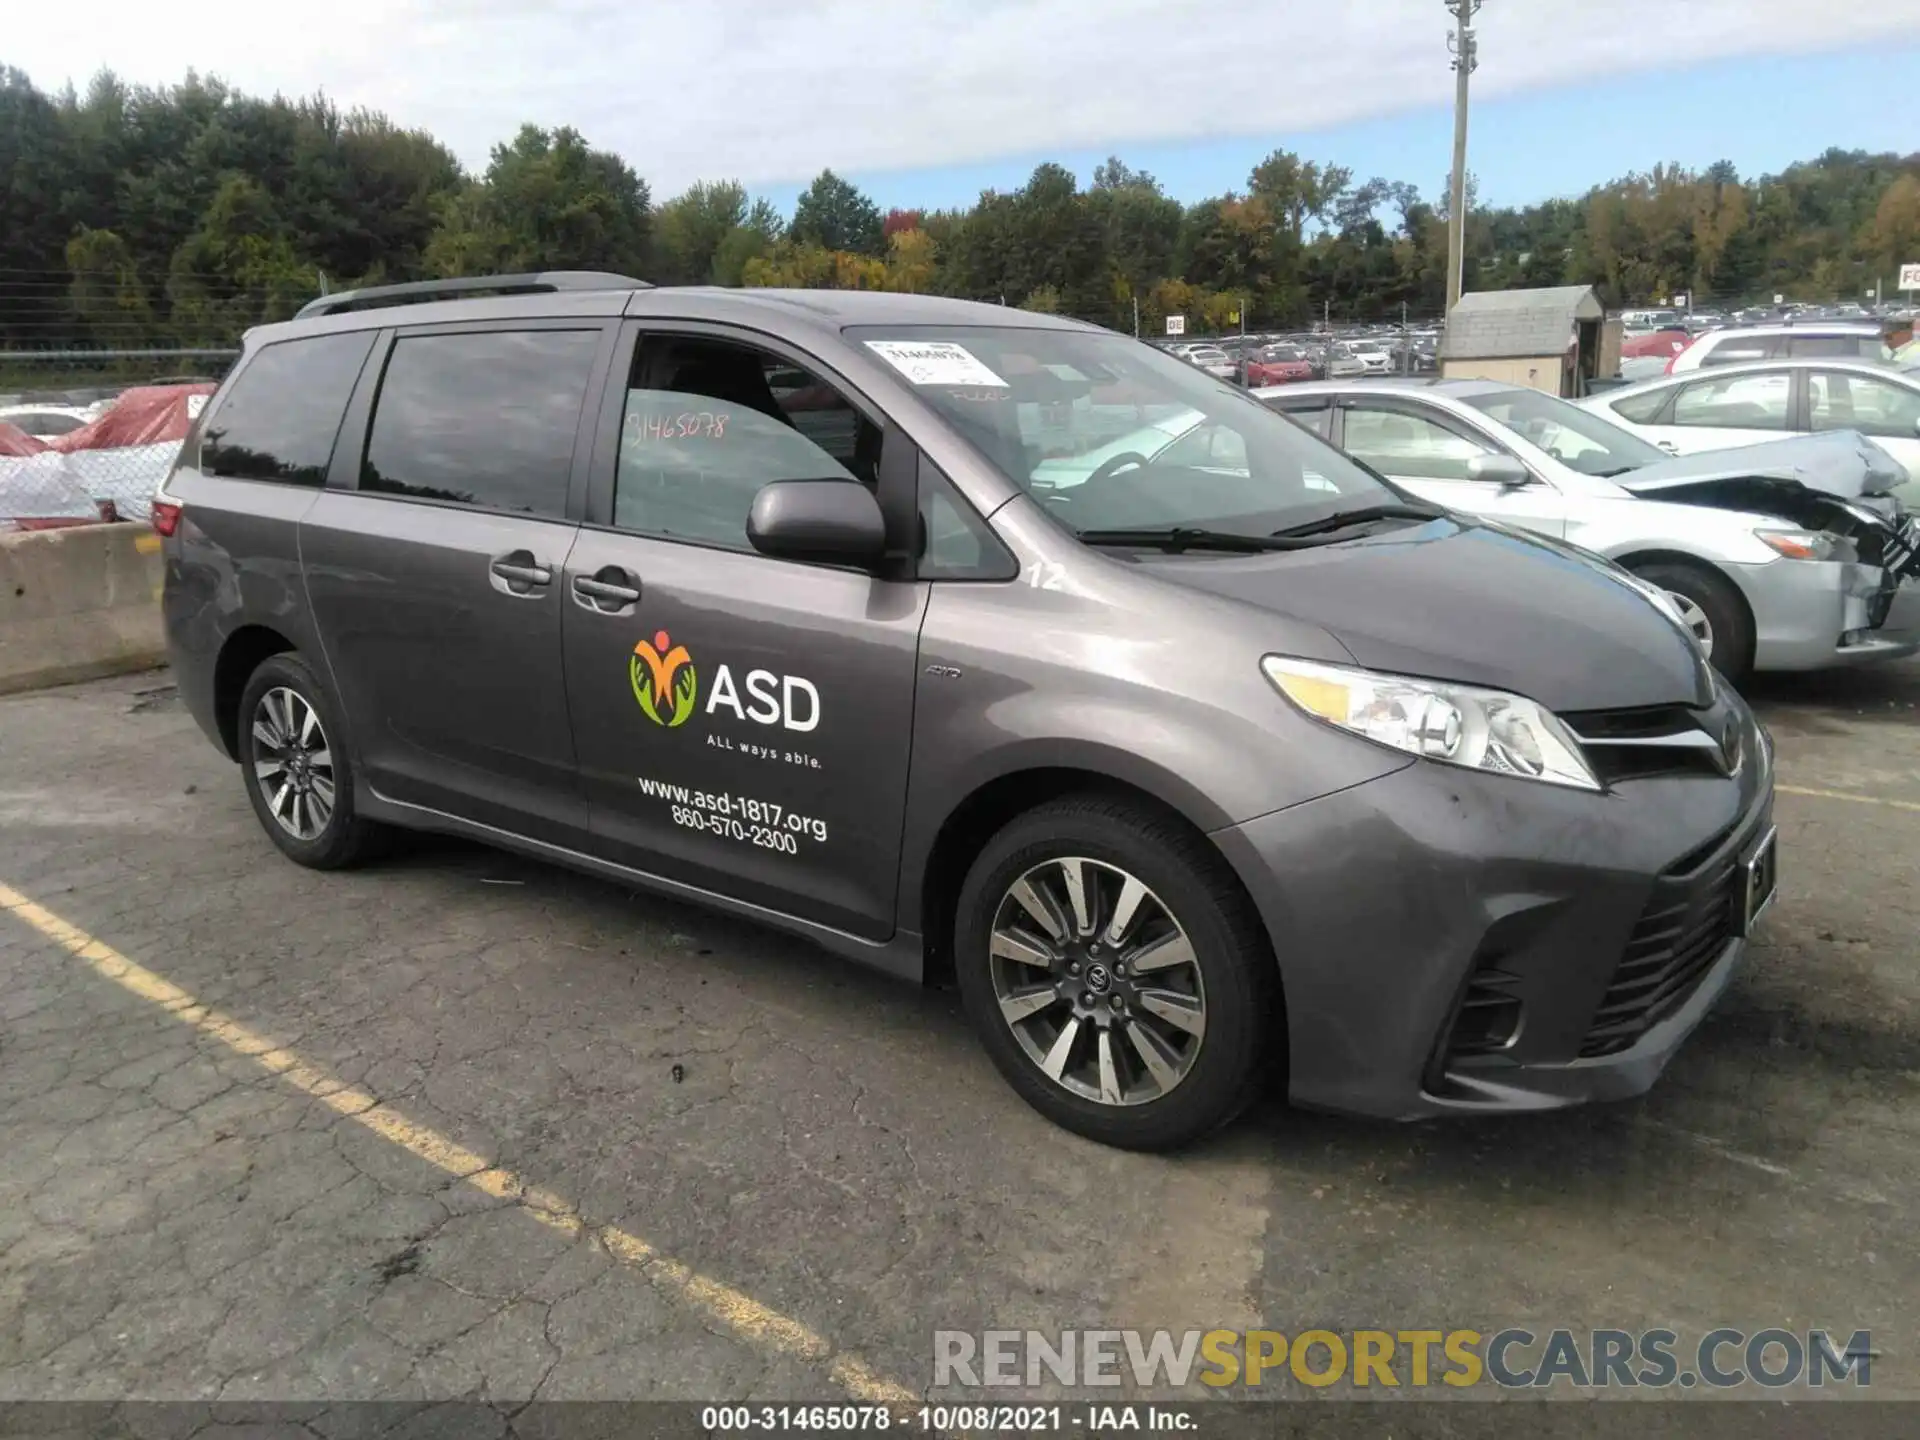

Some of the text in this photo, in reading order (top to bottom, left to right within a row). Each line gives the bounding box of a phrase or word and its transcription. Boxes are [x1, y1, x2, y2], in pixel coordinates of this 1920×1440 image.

[627, 412, 729, 449] 31465078
[705, 664, 821, 732] ASD
[707, 734, 734, 750] ALL
[740, 742, 778, 760] ways
[638, 777, 828, 842] www.asd-1817.org
[671, 804, 798, 855] 860-570-2300
